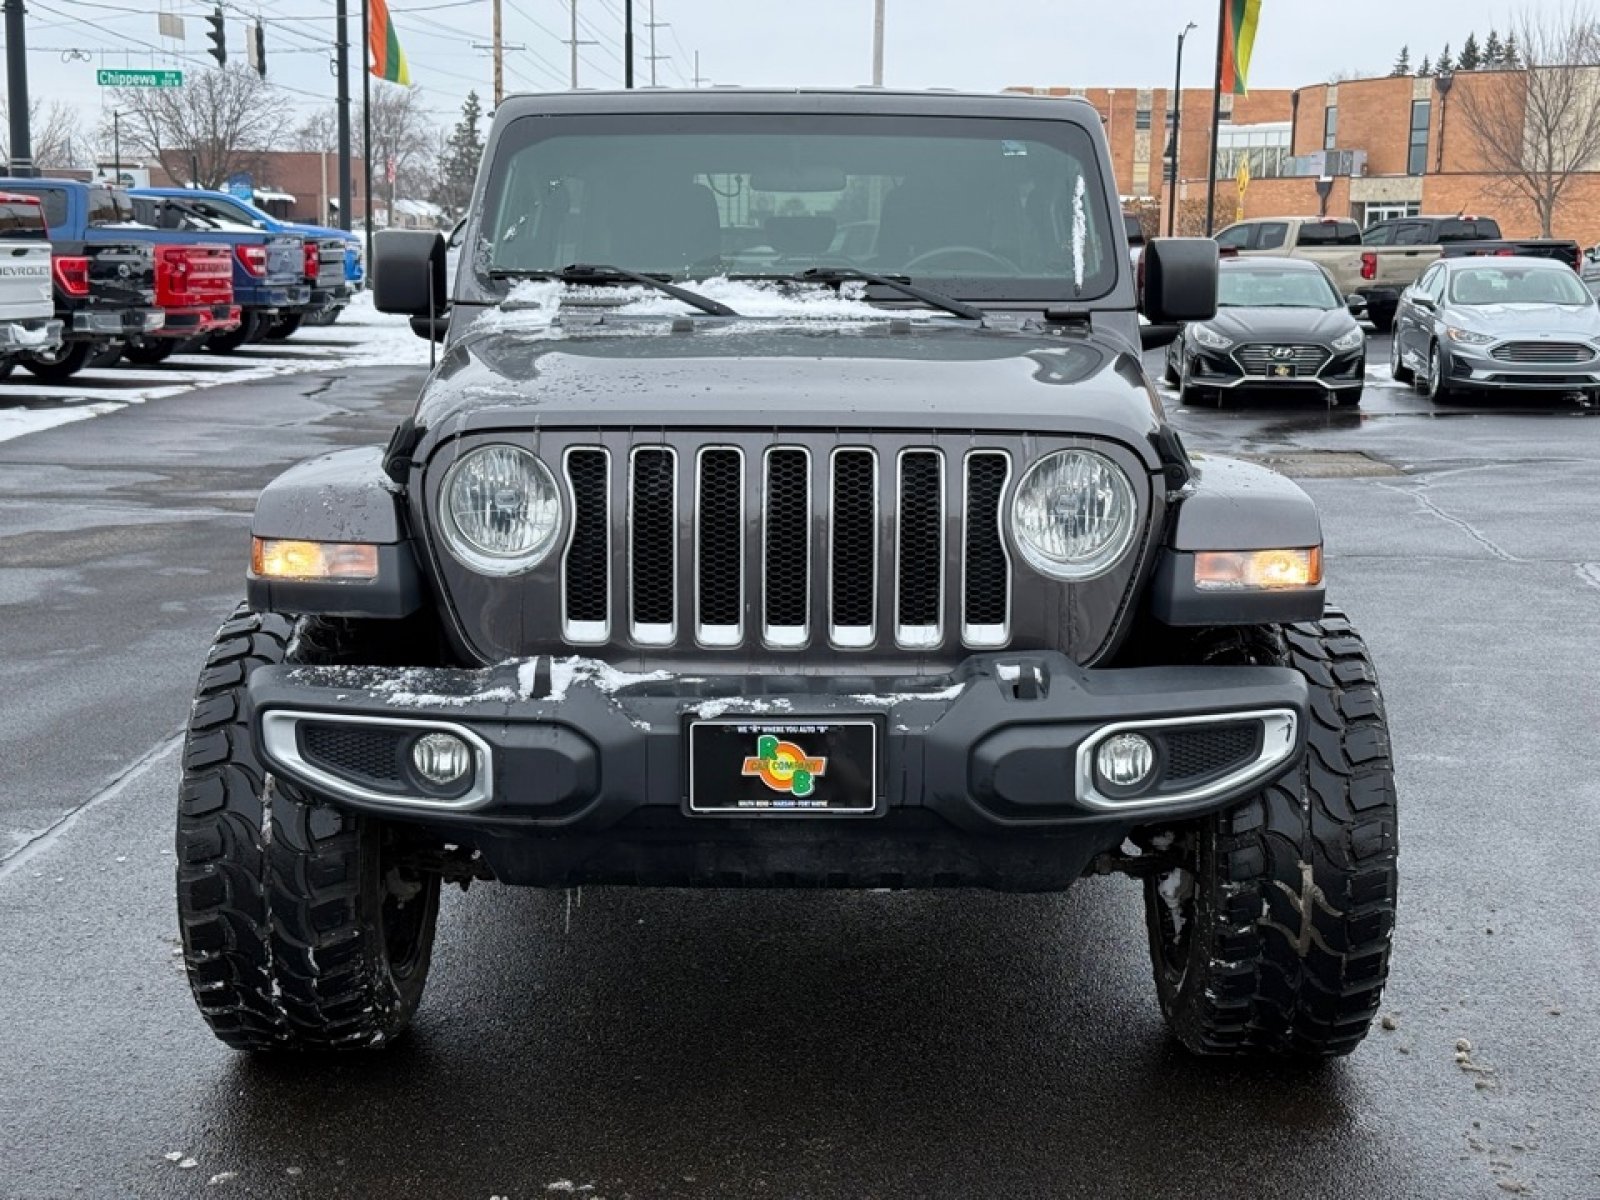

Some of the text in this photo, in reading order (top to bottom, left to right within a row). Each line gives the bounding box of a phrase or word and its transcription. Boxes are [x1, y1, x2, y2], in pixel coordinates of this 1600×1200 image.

[99, 71, 156, 86] Chippewa
[758, 735, 779, 760] R
[750, 761, 817, 771] CAR COMPANY
[792, 770, 815, 797] B
